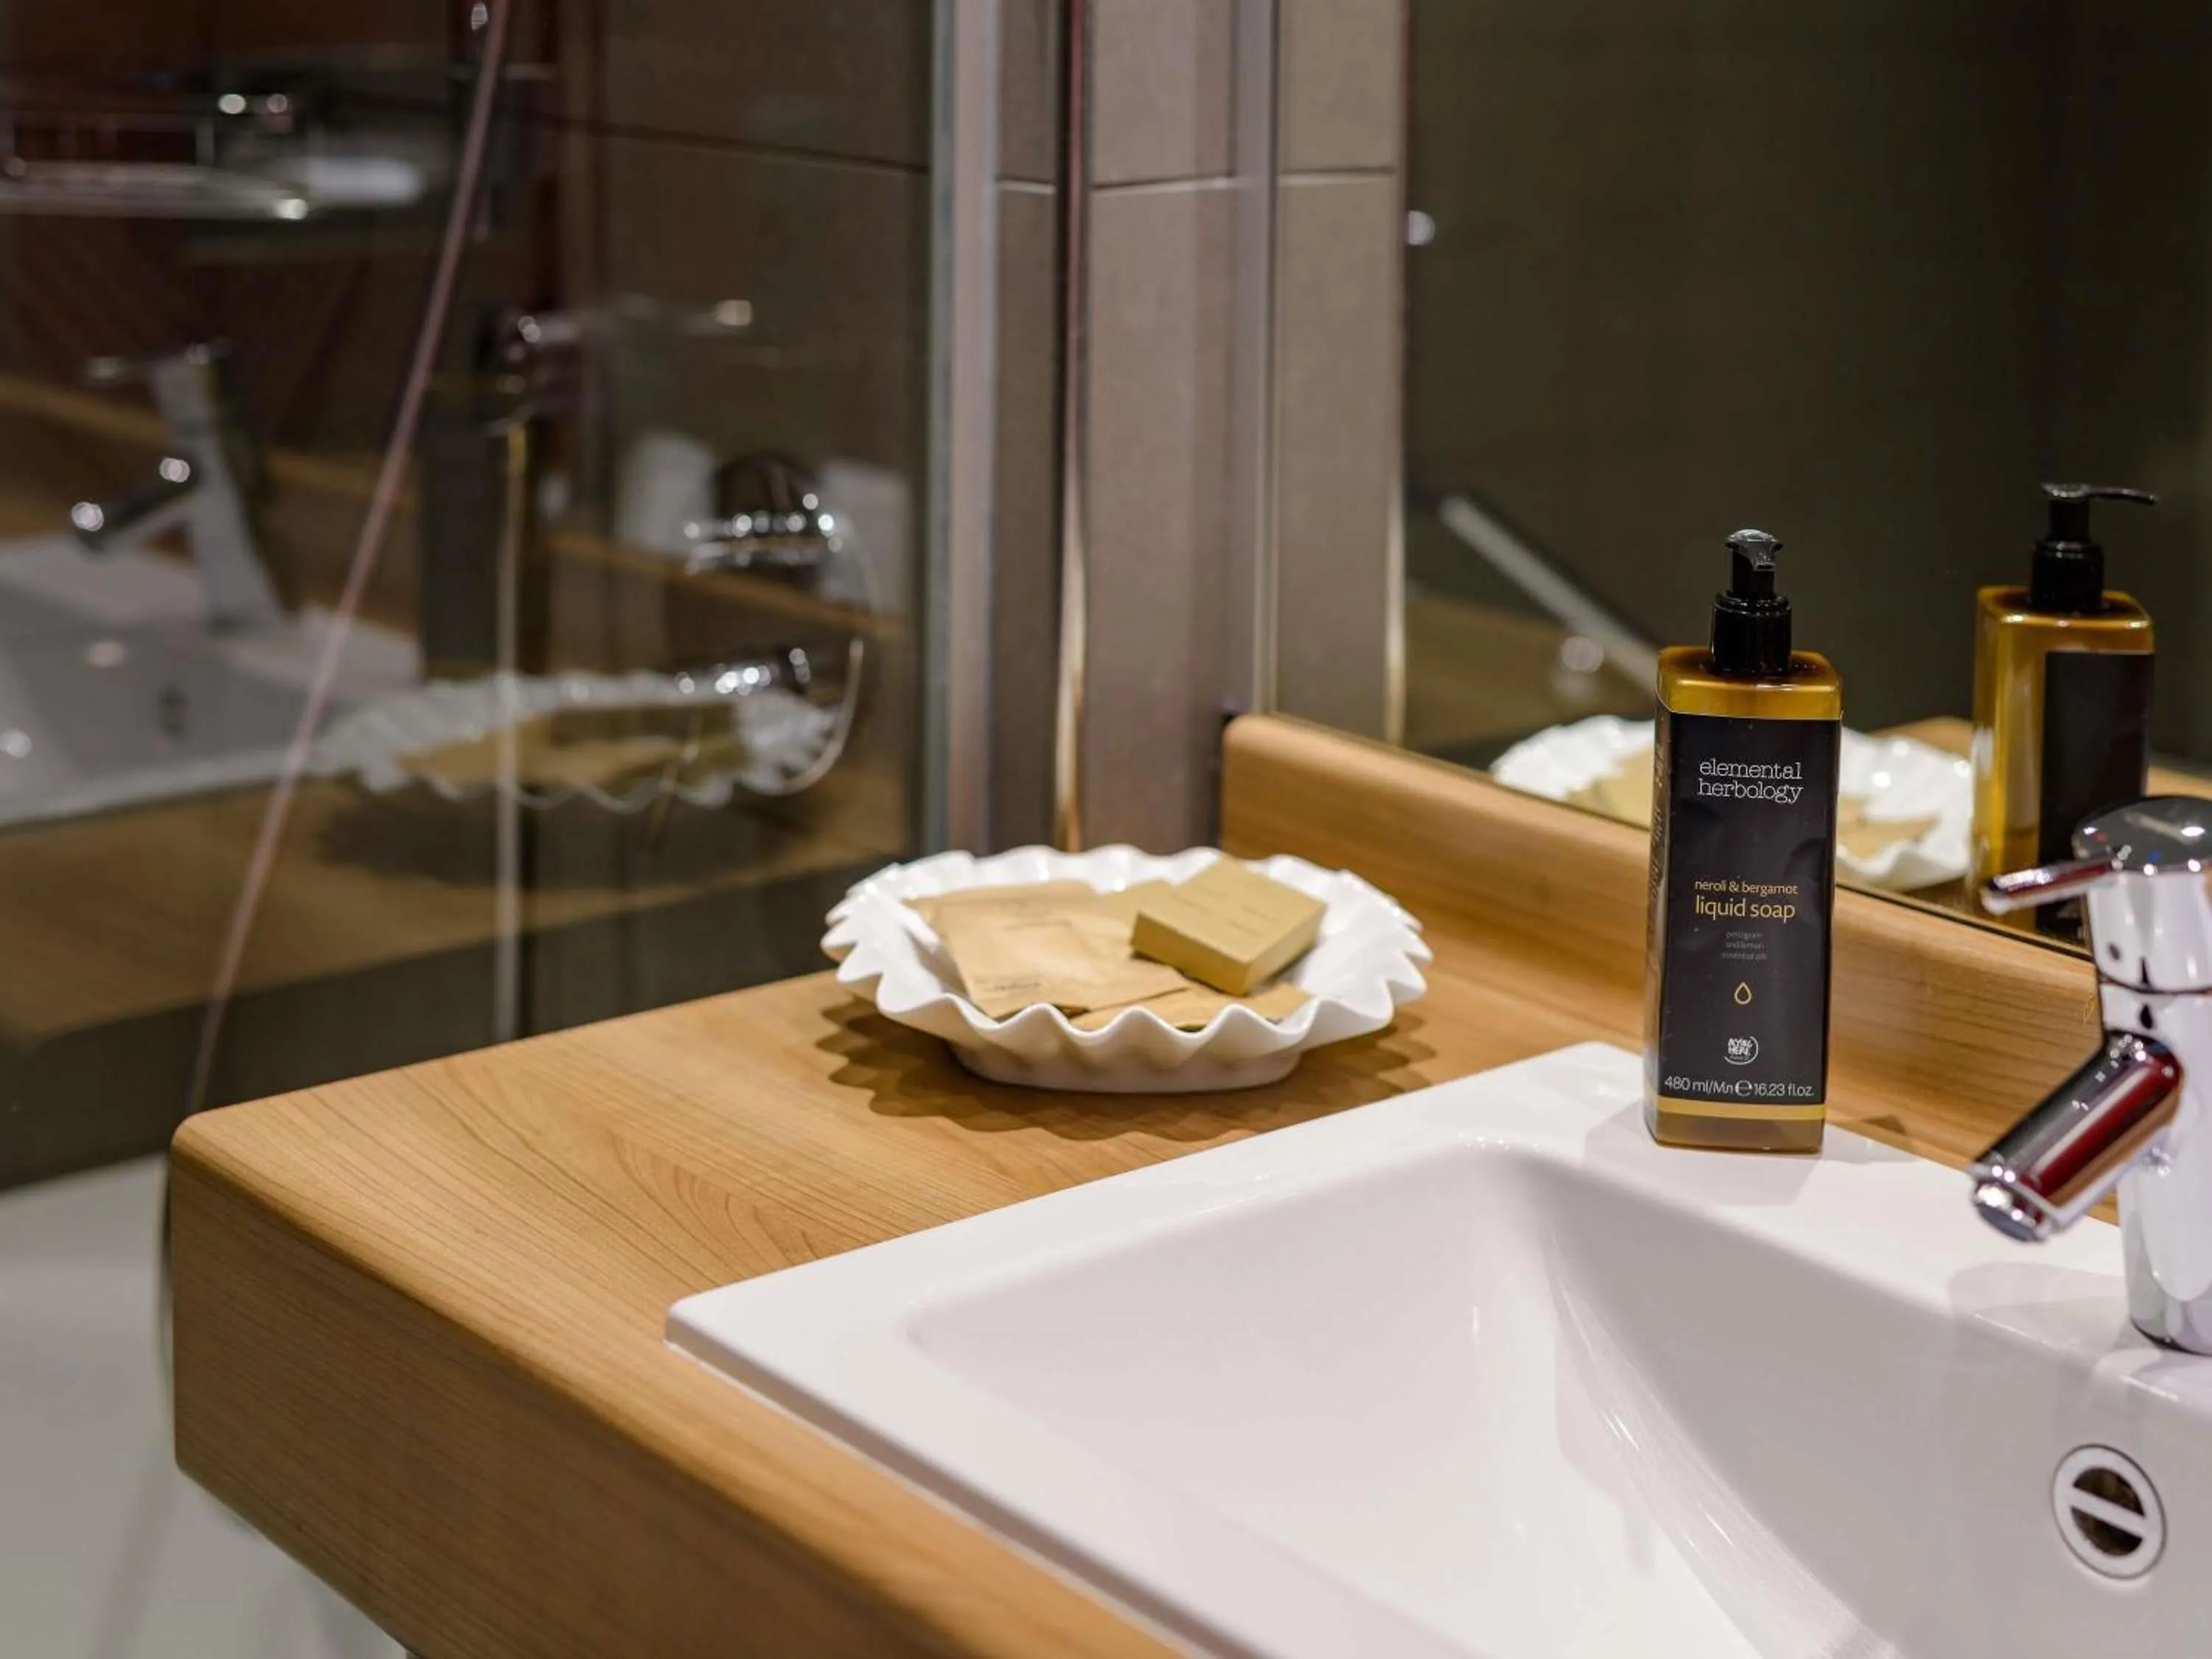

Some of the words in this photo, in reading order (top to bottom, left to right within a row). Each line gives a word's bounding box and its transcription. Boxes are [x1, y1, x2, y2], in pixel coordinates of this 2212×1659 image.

[1700, 758, 1802, 779] elemental
[1698, 779, 1804, 804] herbology
[1695, 880, 1726, 892] neroli
[1729, 881, 1739, 892] &
[1742, 881, 1798, 897] bergamot
[1696, 895, 1746, 921] liquid
[1750, 903, 1796, 923] soap
[1664, 1076, 1691, 1091] 480
[1753, 1083, 1785, 1096] 16.23
